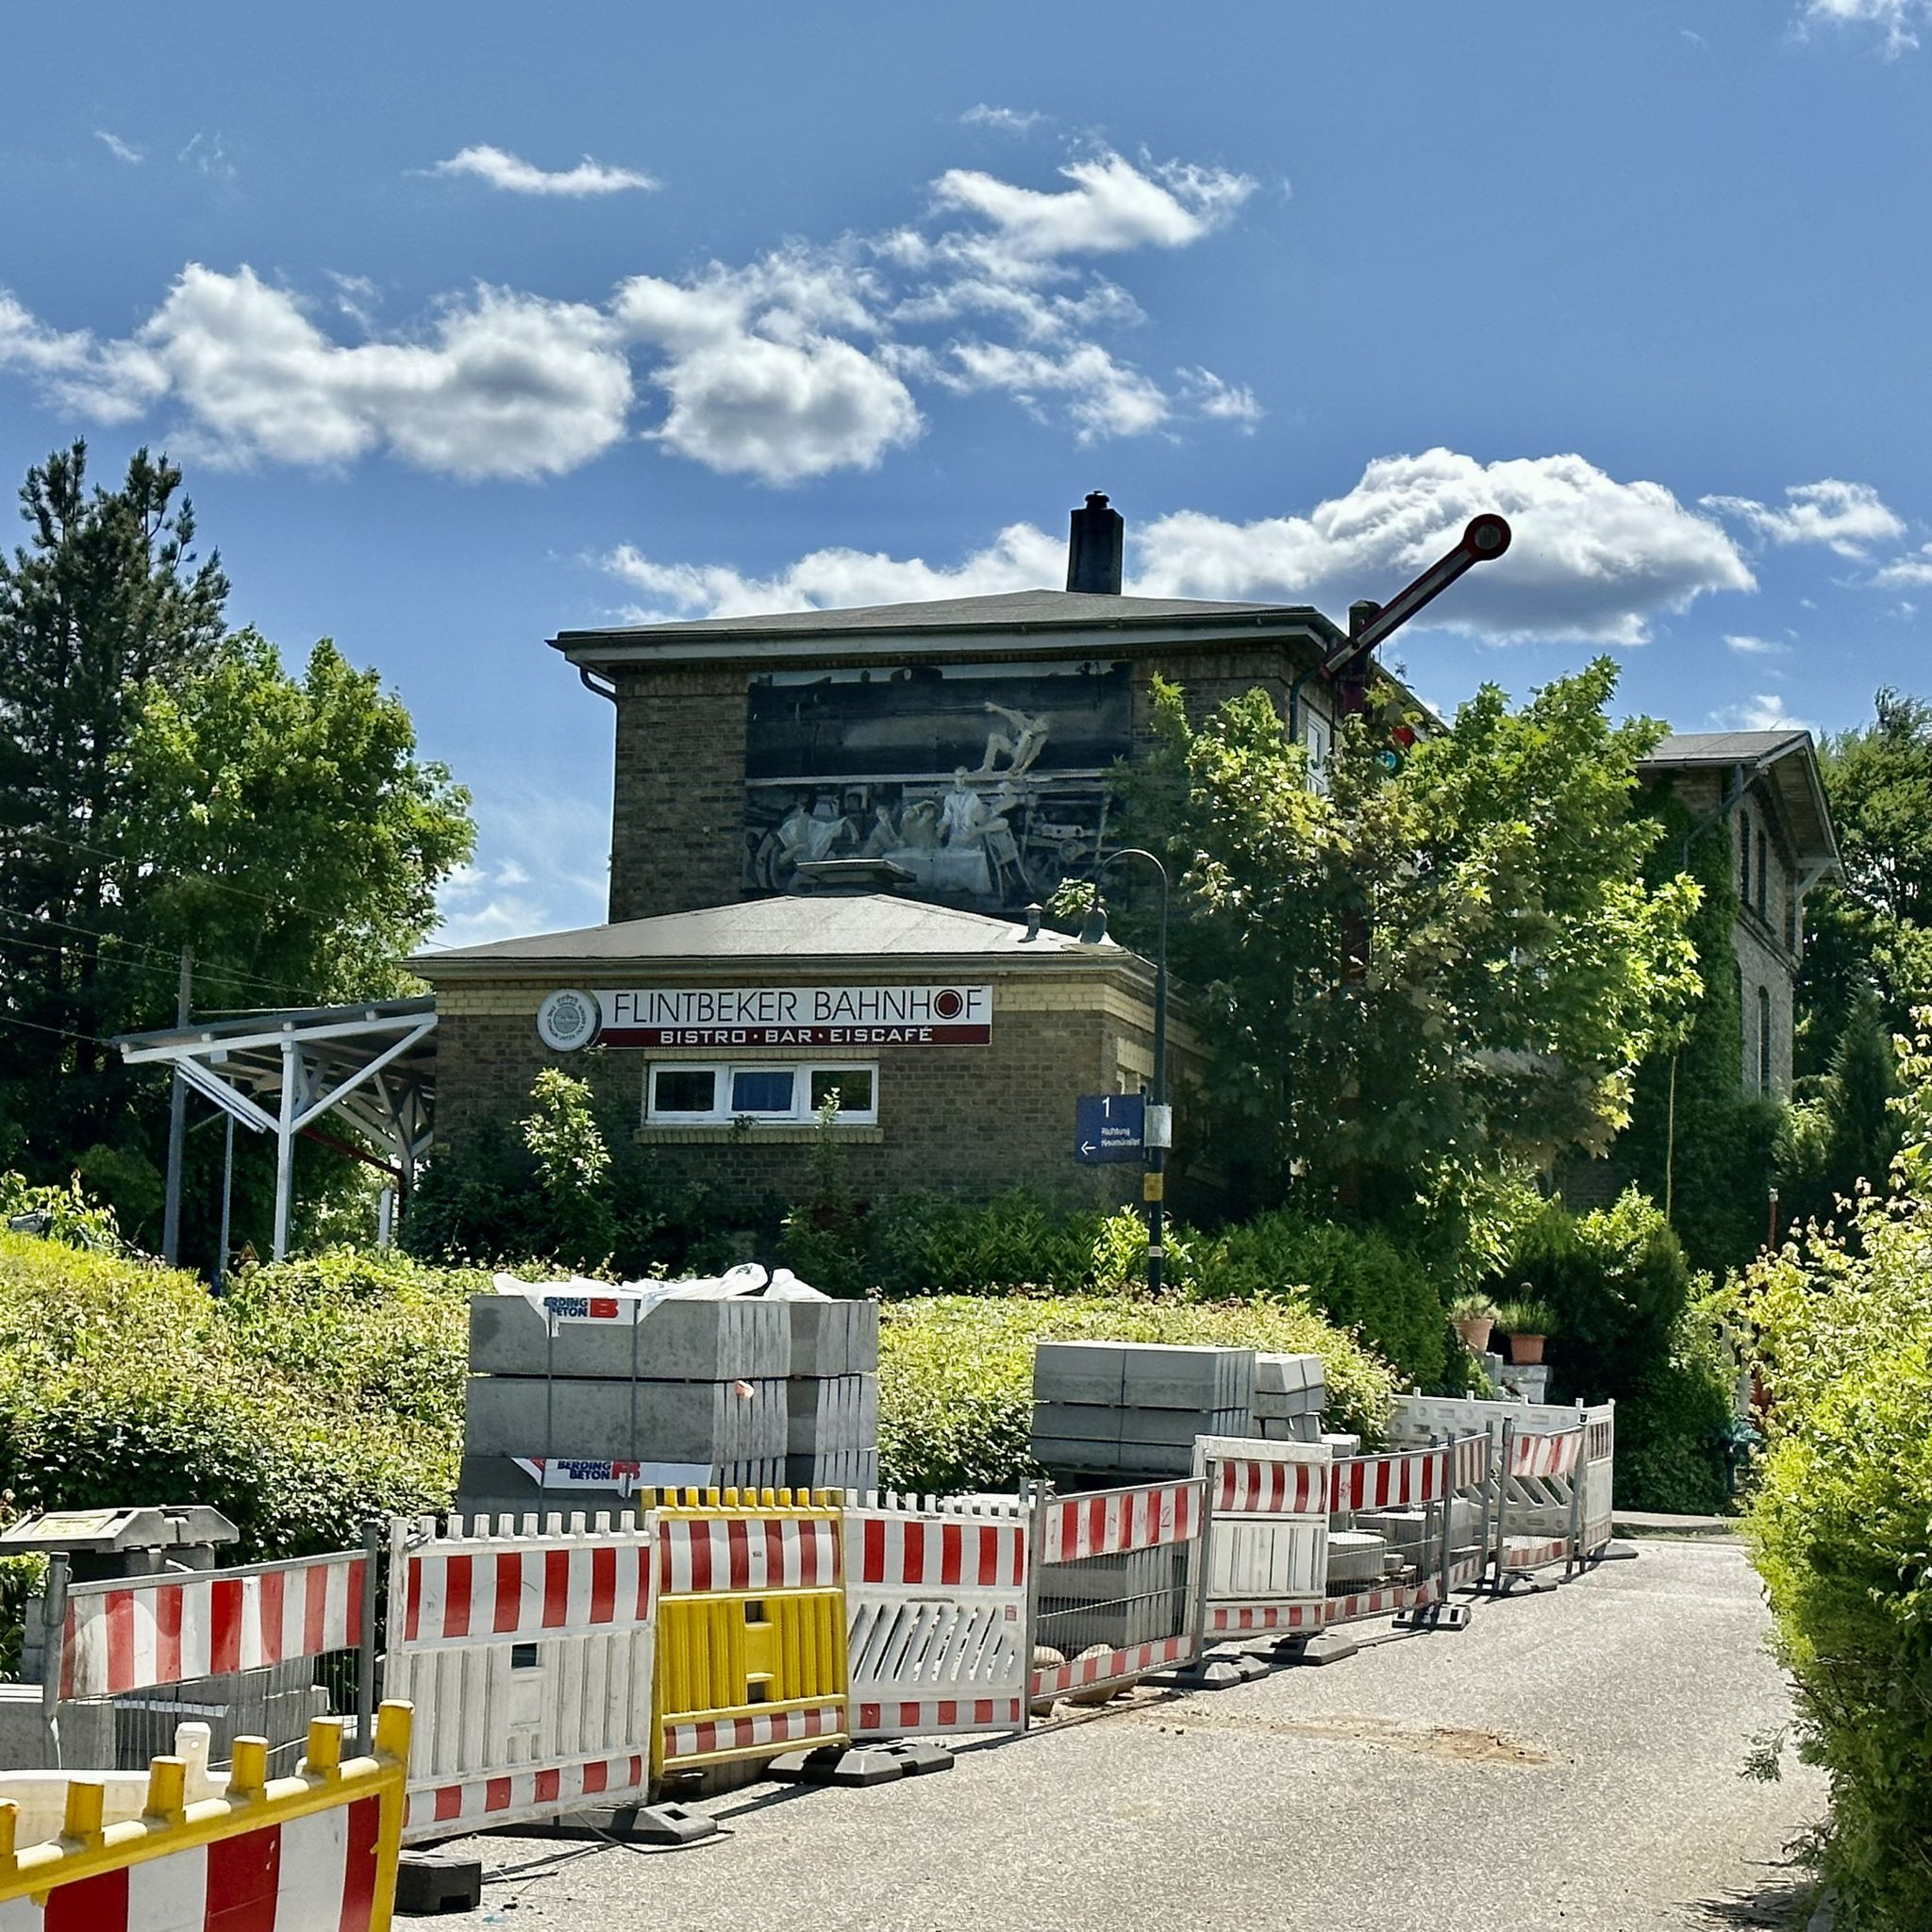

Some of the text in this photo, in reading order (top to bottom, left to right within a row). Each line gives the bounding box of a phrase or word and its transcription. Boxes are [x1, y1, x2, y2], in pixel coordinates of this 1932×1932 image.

[614, 991, 797, 1023] FLINTBEKER
[814, 989, 982, 1021] BAHNHOF
[660, 1025, 933, 1044] BISTRO BAR EISCAFÉ
[1102, 1096, 1110, 1118] 1
[558, 1460, 611, 1470] BERDING
[569, 1471, 610, 1480] BETON
